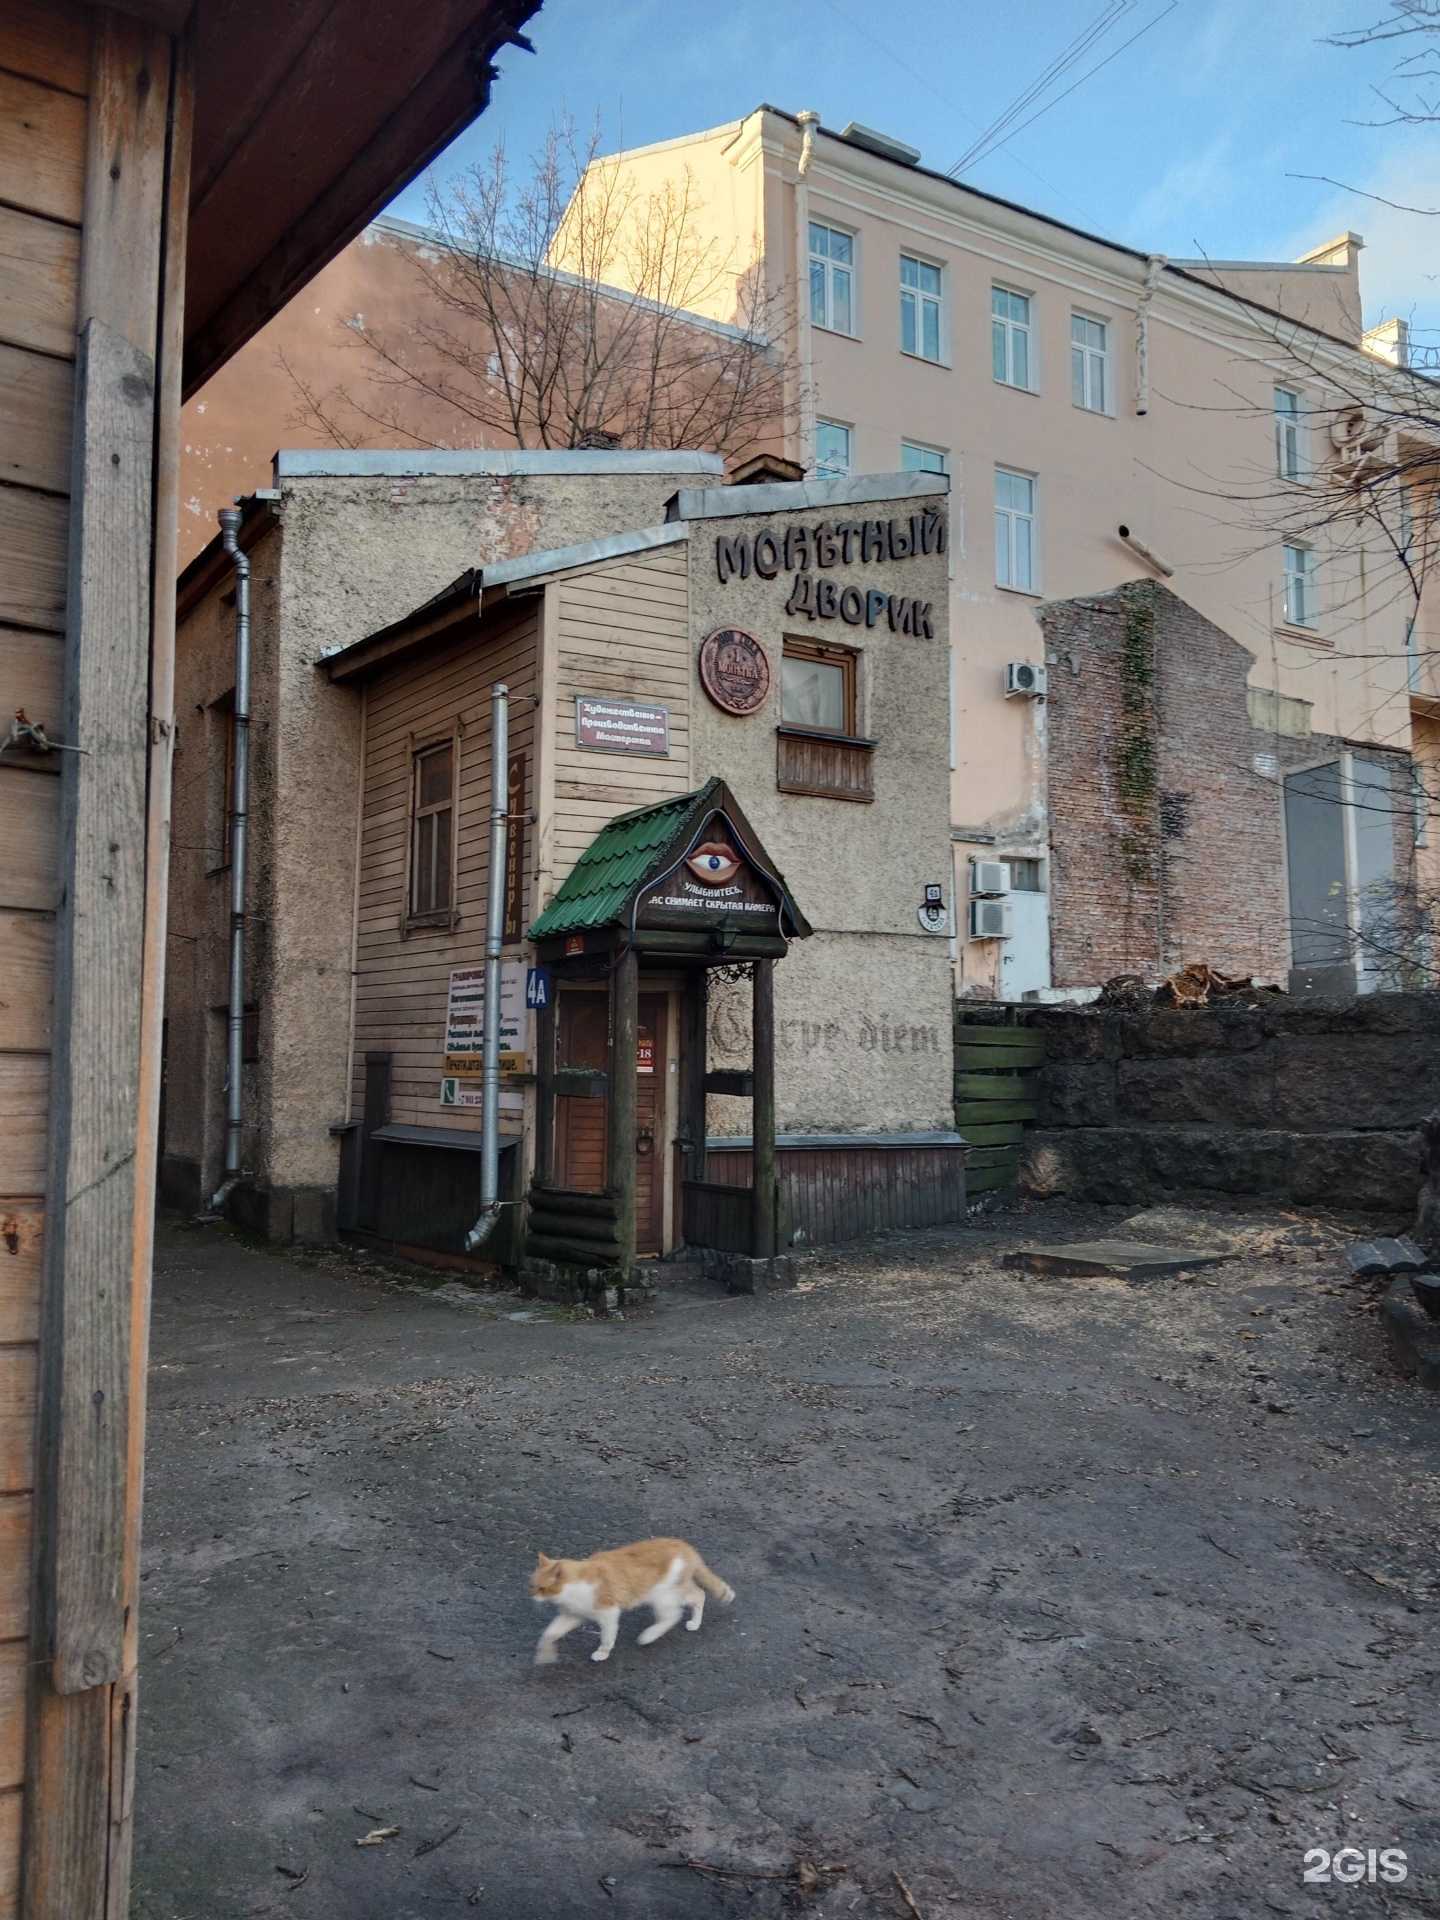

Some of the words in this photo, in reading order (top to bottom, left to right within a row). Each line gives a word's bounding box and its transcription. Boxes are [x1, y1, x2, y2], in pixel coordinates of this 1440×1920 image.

[784, 572, 934, 640] ДВОРИК
[664, 896, 704, 908] СНИМАЕТ
[705, 898, 744, 911] СКРЫТАЯ
